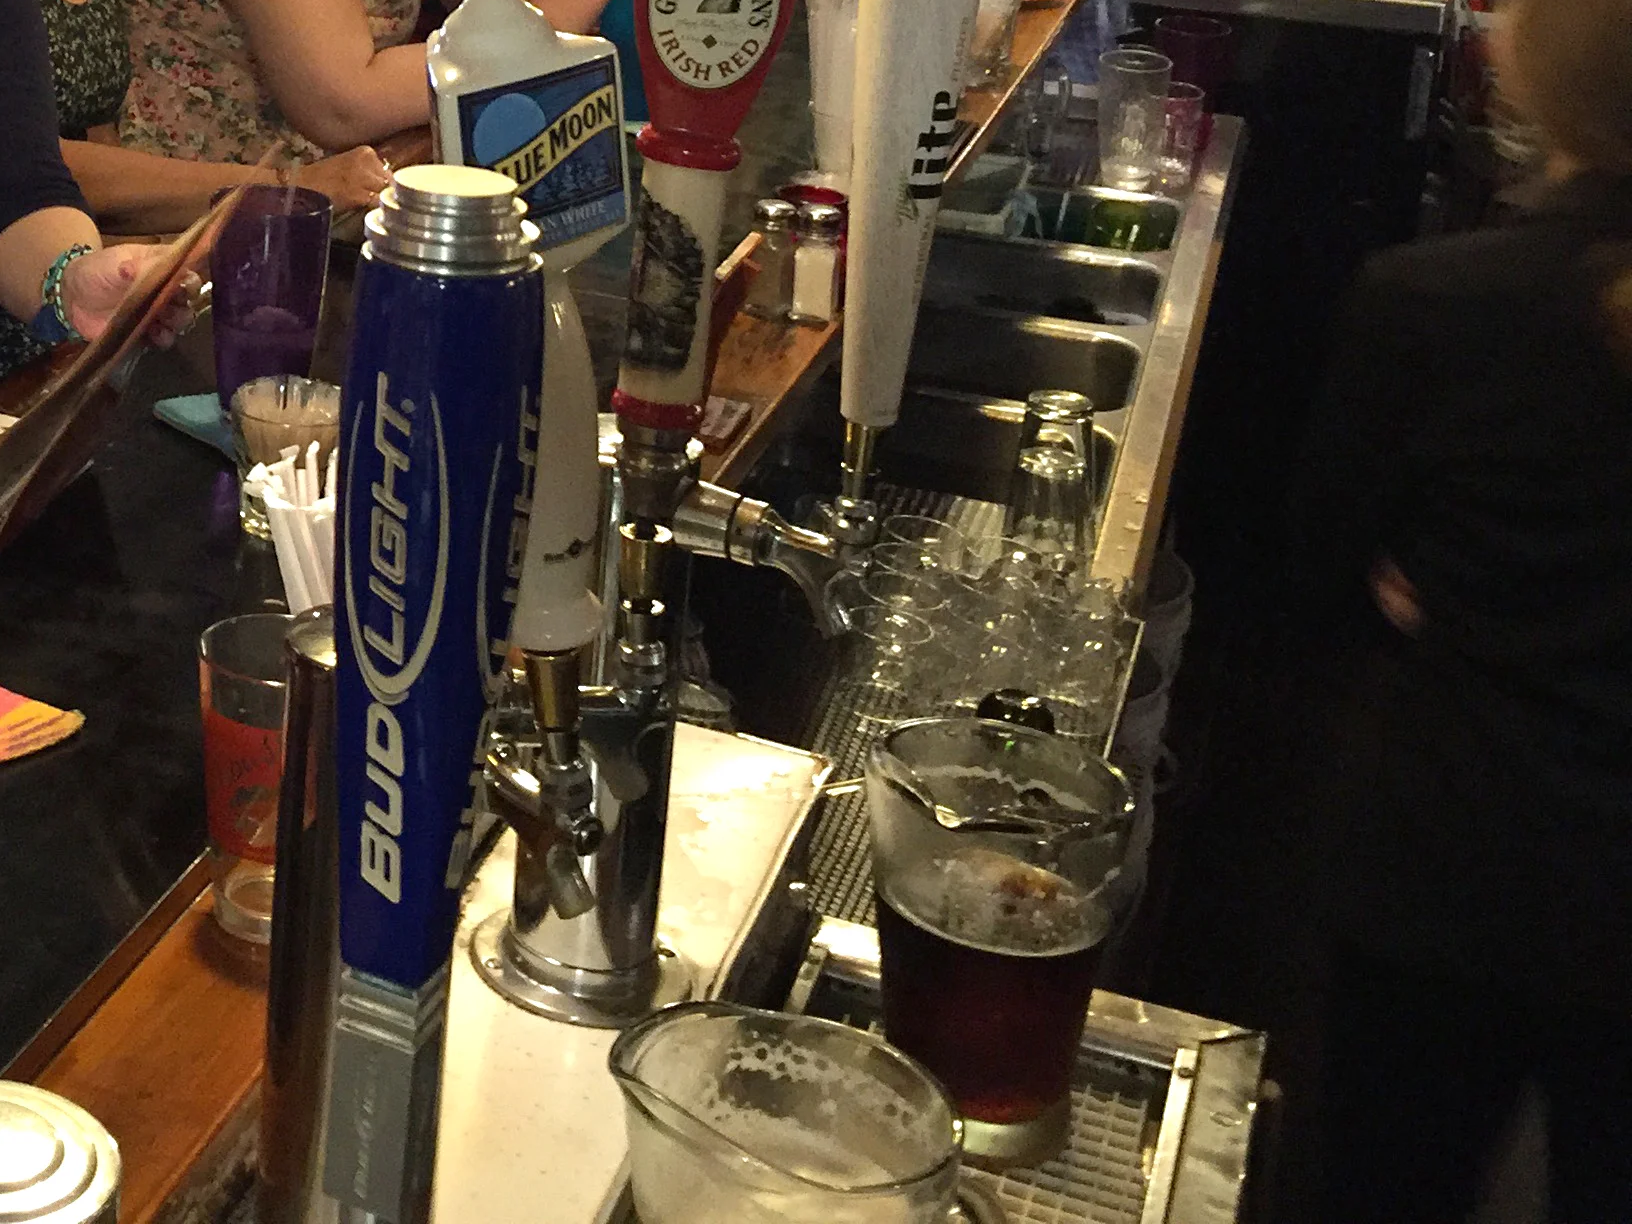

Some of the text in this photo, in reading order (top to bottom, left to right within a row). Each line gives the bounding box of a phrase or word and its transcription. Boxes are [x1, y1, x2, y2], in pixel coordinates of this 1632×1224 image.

[657, 29, 760, 81] IRISH RED
[548, 92, 613, 161] MOON
[360, 371, 411, 904] BUD LIGHT
